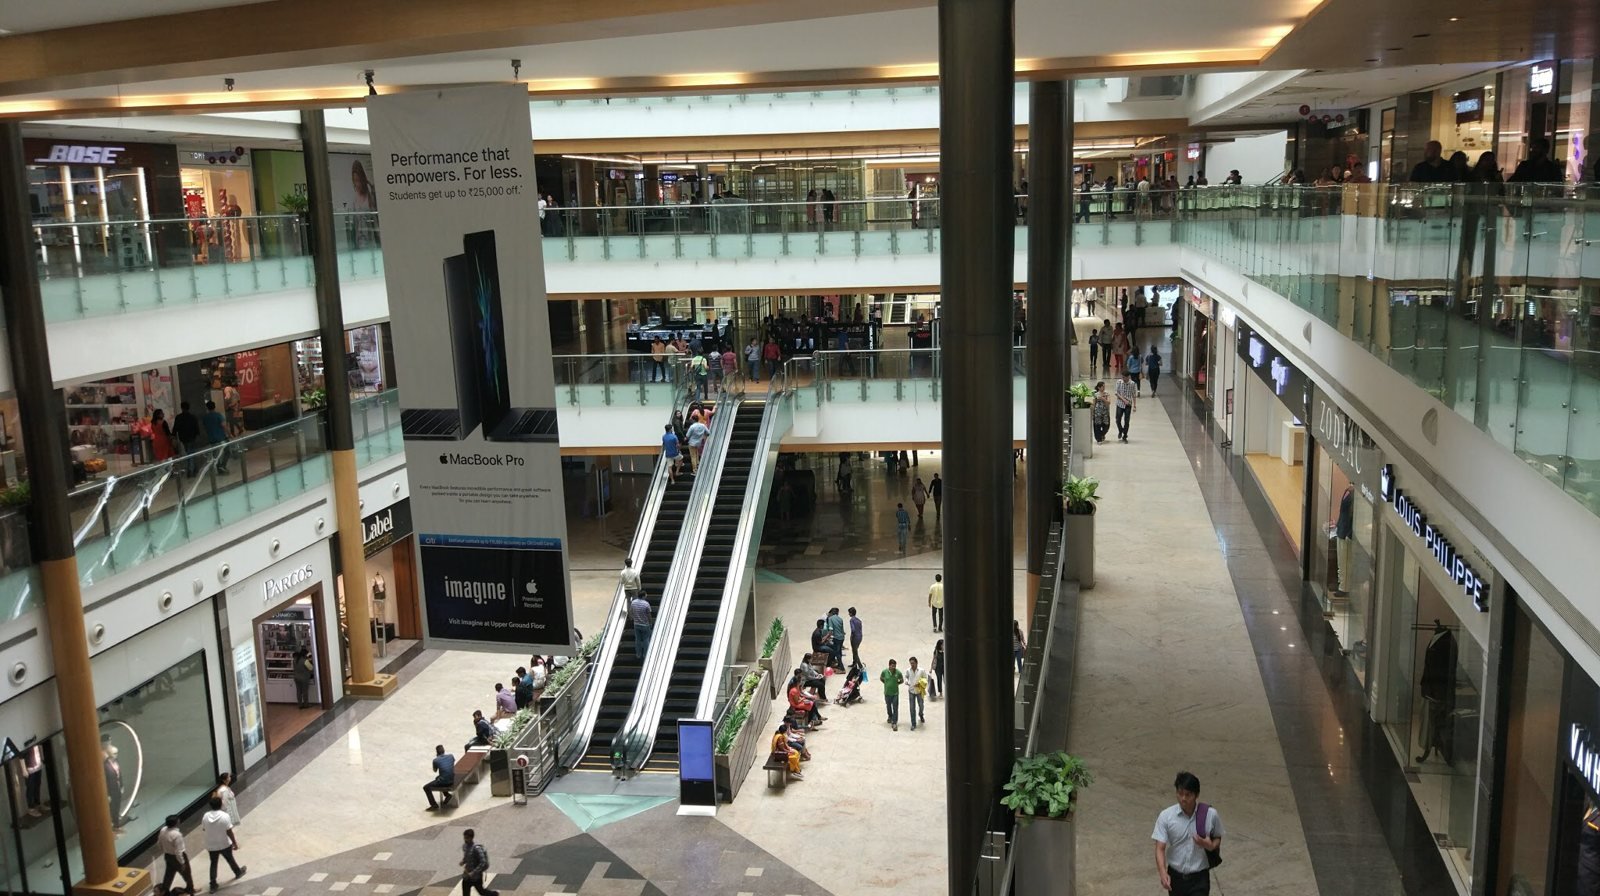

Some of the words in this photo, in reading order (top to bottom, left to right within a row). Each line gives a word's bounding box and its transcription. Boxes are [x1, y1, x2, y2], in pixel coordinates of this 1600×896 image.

[34, 145, 125, 164] BOSE
[391, 151, 478, 167] Performance
[481, 147, 510, 161] that
[386, 170, 460, 186] empowers.
[463, 167, 486, 180] For
[490, 165, 522, 179] less.
[389, 191, 426, 201] Students
[428, 190, 442, 201] get
[444, 190, 456, 200] up
[458, 189, 467, 198] to
[1319, 400, 1362, 475] ZODIAC
[449, 453, 503, 466] MacBook
[505, 454, 525, 467] Pro
[361, 508, 394, 544] Label
[1393, 490, 1424, 537] LOUIS
[1425, 523, 1486, 611] PHILIPPE
[262, 563, 314, 601] PARCOS
[444, 575, 506, 605] imagine
[448, 617, 461, 625] Visit
[461, 618, 484, 628] Imagine
[490, 620, 508, 629] Upper
[508, 621, 530, 629] Ground
[530, 622, 546, 630] Floor
